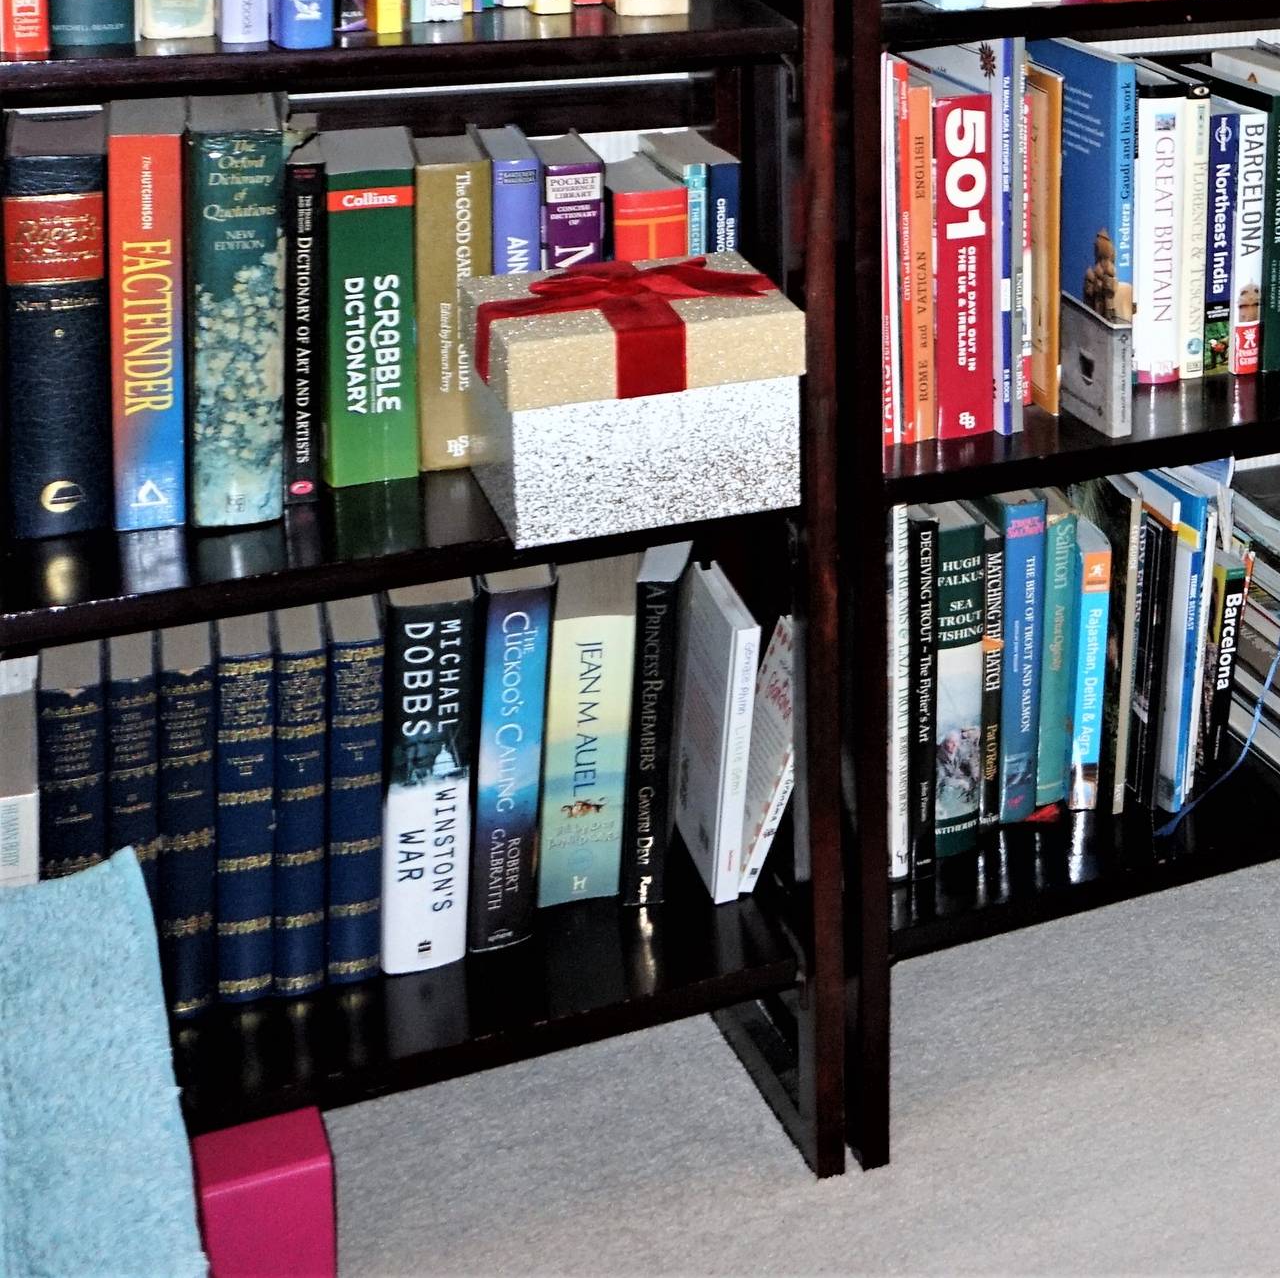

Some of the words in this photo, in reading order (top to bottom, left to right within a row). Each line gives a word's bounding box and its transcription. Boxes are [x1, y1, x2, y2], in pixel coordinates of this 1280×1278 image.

[142, 156, 151, 170] The
[550, 176, 597, 187] POCKET
[914, 135, 926, 199] ENGLISH
[945, 108, 987, 240] 501
[1154, 136, 1176, 217] GREAT
[141, 171, 153, 230] HUTCHINSON
[342, 193, 397, 207] Collins
[552, 185, 596, 193] REFERENCE
[555, 191, 593, 200] LIBRARY
[557, 204, 592, 213] CONCISE
[1213, 163, 1230, 248] Northeast
[1240, 123, 1265, 257] BARCELONA
[550, 211, 598, 220] DICTIONARY
[296, 237, 313, 322] DICTIONARY
[957, 247, 967, 273] THE
[966, 246, 976, 287] GREAT
[1153, 225, 1174, 323] BRITAIN
[1212, 251, 1229, 294] India
[916, 251, 927, 314] VATICAN
[957, 276, 967, 293] UK
[957, 297, 967, 307] &
[966, 291, 976, 324] DAYS
[122, 239, 173, 416] FACTFINDER
[296, 326, 312, 344] OF
[343, 276, 367, 413] DICTIONARY
[370, 274, 401, 413] SCRABBLE
[918, 325, 928, 348] and
[957, 310, 967, 366] IRELAND
[966, 328, 976, 353] OUT
[296, 348, 312, 374] ART
[966, 357, 976, 371] IN
[296, 379, 312, 405] AND
[918, 360, 928, 402] ROME
[296, 410, 312, 463] ARTISTS
[919, 530, 932, 600] DECEIVING
[943, 555, 981, 571] HUGH
[1025, 556, 1036, 578] THE
[1053, 524, 1073, 589] Salmon
[938, 570, 984, 587] FALKUS
[1024, 580, 1035, 604] BEST
[919, 602, 933, 642] TROUT
[938, 610, 982, 627] TROUT
[950, 599, 973, 612] SEA
[1024, 607, 1034, 622] OF
[521, 627, 539, 654] THE
[1022, 623, 1034, 661] TROUT
[1083, 608, 1102, 675] Rajasthan,
[1217, 592, 1243, 690] Barcelona
[401, 622, 434, 738] DOBBS
[437, 619, 461, 733] MICHAEL
[501, 611, 530, 717] CUCKOO'S
[919, 655, 933, 675] The
[1021, 663, 1033, 686] AND
[917, 678, 933, 720] Flytier's
[1020, 688, 1031, 733] SALMON
[1082, 677, 1098, 710] Delhi
[918, 723, 930, 743] Art
[1081, 712, 1094, 723] &
[1077, 726, 1092, 756] Agra
[494, 723, 523, 812] CALLING
[637, 786, 654, 833] GAYATRI
[397, 829, 425, 883] WAR
[431, 787, 458, 913] WINSTON'S
[487, 828, 507, 911] GALBRAITH
[504, 837, 521, 892] ROBERT
[636, 837, 653, 865] DEVI
